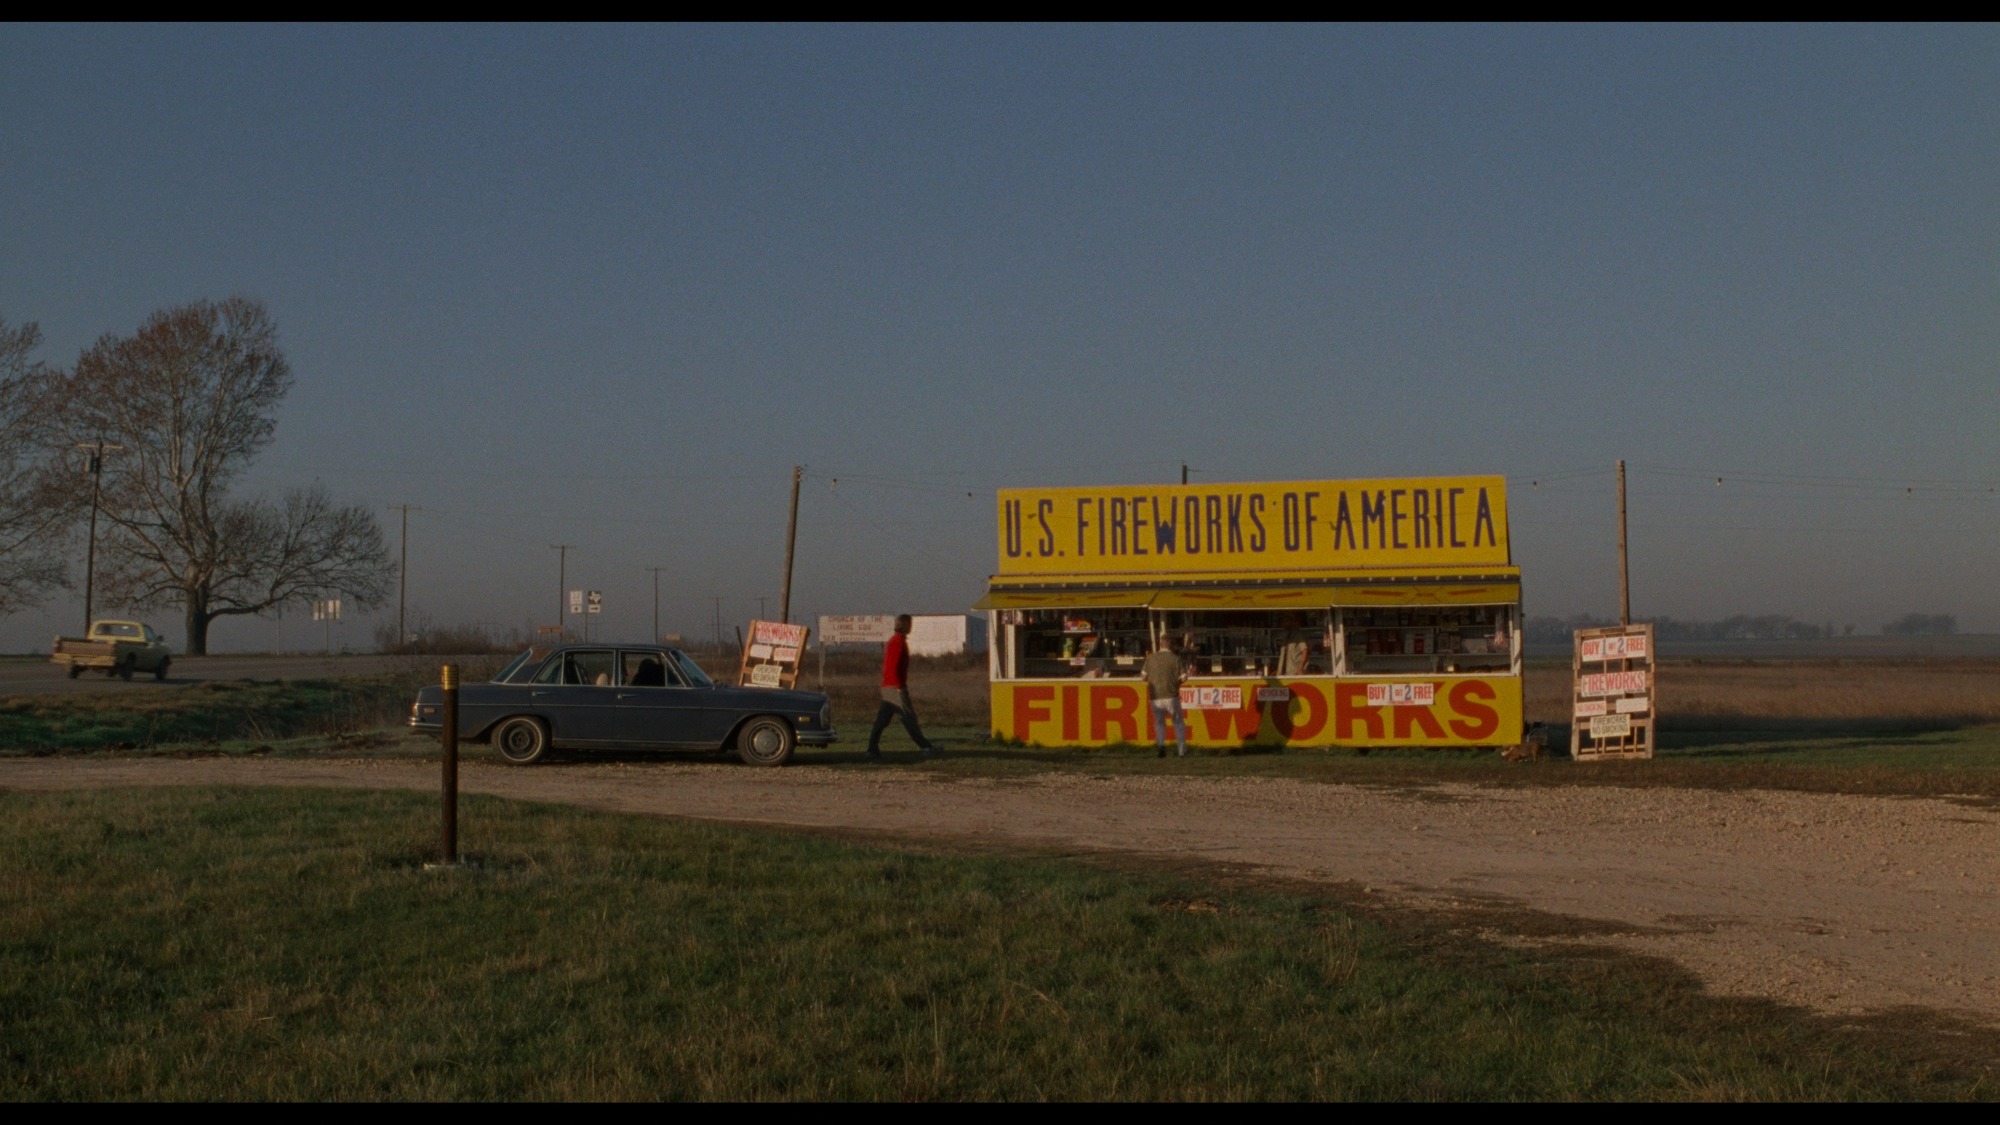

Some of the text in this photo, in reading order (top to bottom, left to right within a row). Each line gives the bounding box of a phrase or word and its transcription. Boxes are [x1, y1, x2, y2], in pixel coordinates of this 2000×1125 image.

[1005, 487, 1497, 558] U.S. FIREWORKS OF AMERICA
[757, 623, 800, 643] FIREWORKS
[1584, 641, 1600, 656] BUY
[1602, 638, 1606, 655] 1
[1617, 637, 1625, 654] 2
[1626, 637, 1645, 651] FREE
[1582, 671, 1644, 692] FIREWORKS
[1197, 689, 1202, 704] 1
[1213, 688, 1220, 704] 2
[1222, 689, 1240, 703] FREE
[1369, 686, 1386, 700] BUY
[1388, 684, 1393, 701] 1
[1405, 684, 1411, 701] 2
[1414, 686, 1432, 699] FREE
[1593, 715, 1627, 726] FIREWORKS
[1593, 724, 1628, 735] NO SMOKING
